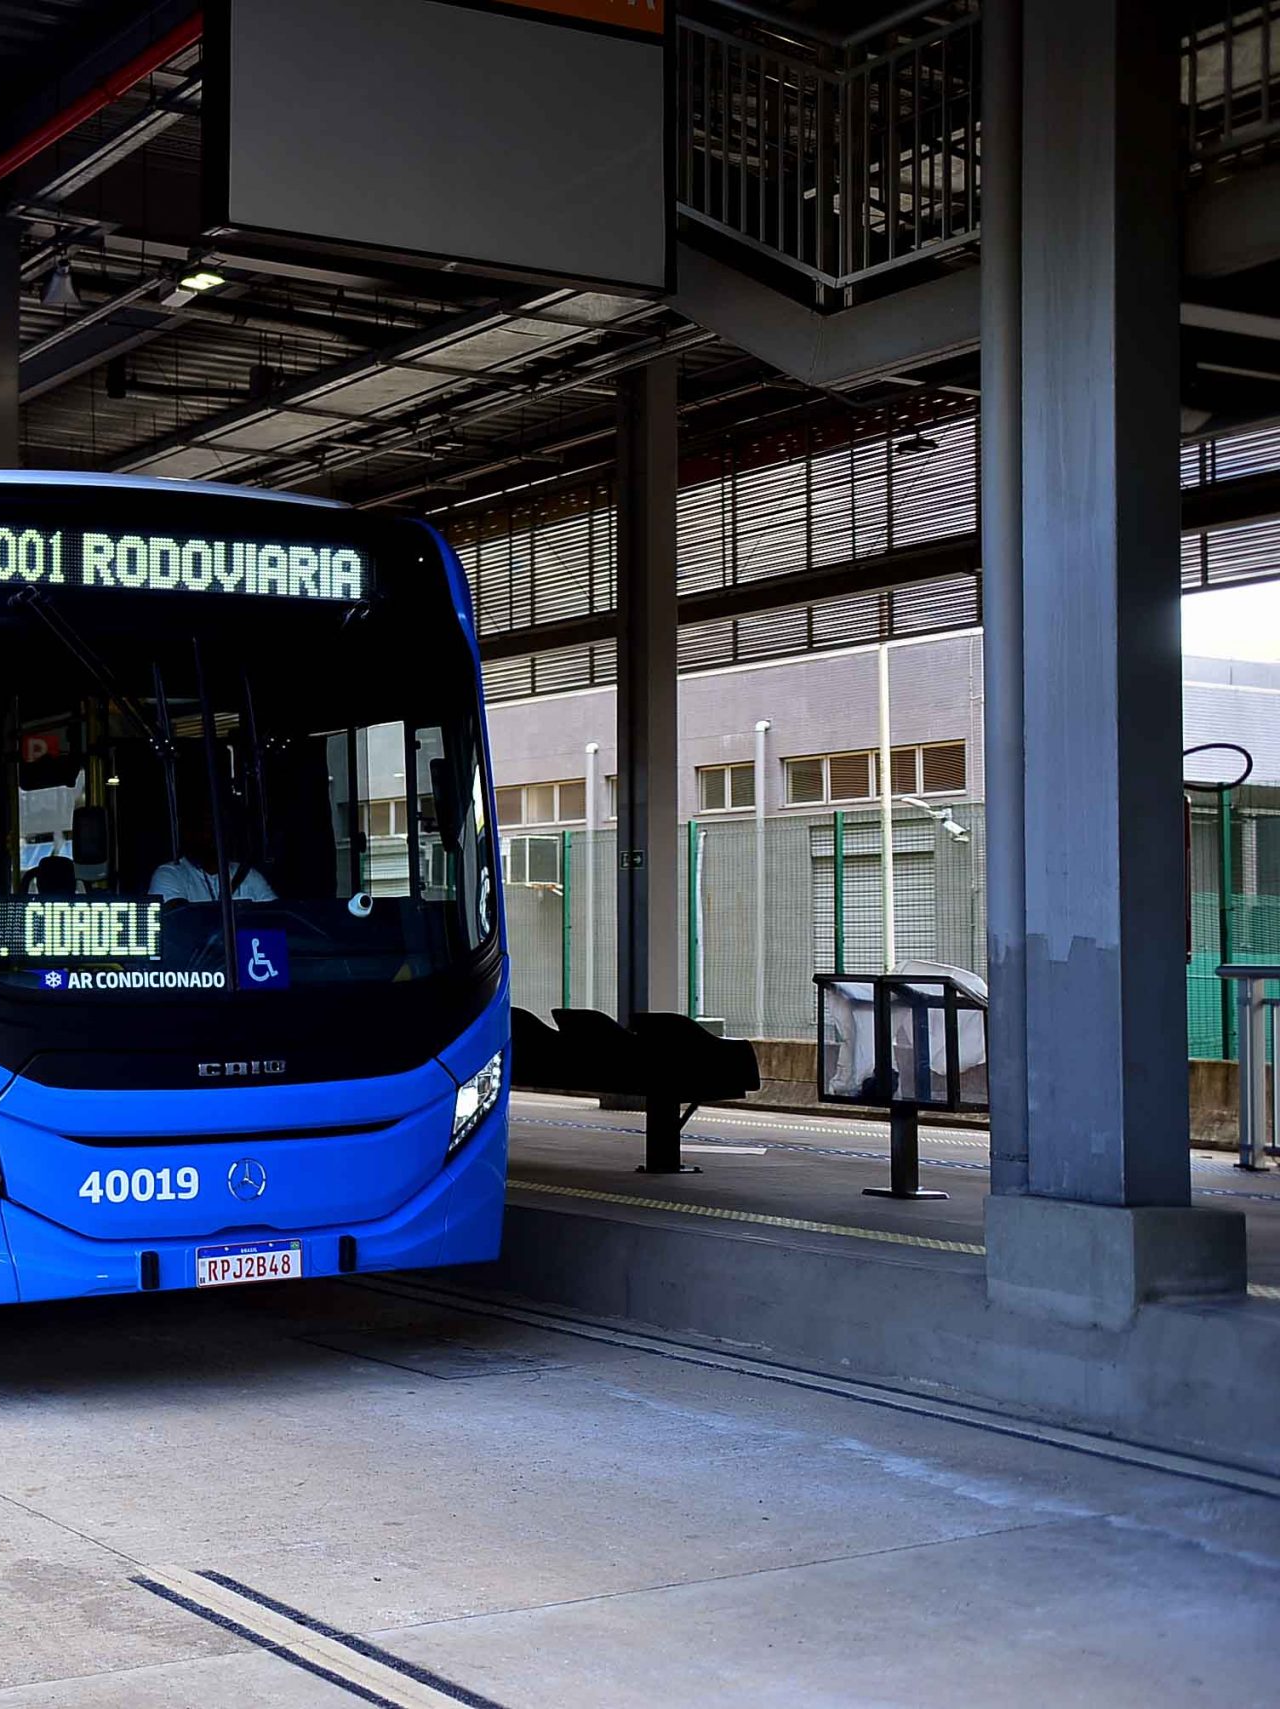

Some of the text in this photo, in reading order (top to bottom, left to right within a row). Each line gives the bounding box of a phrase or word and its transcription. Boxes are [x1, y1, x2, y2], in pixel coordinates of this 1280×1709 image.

[82, 532, 361, 599] RODOVIARIA
[68, 971, 226, 989] AR CONDICIONADO
[198, 1061, 286, 1077] CAIO
[79, 1166, 199, 1203] 40019
[208, 1254, 290, 1281] RPJ2B48
